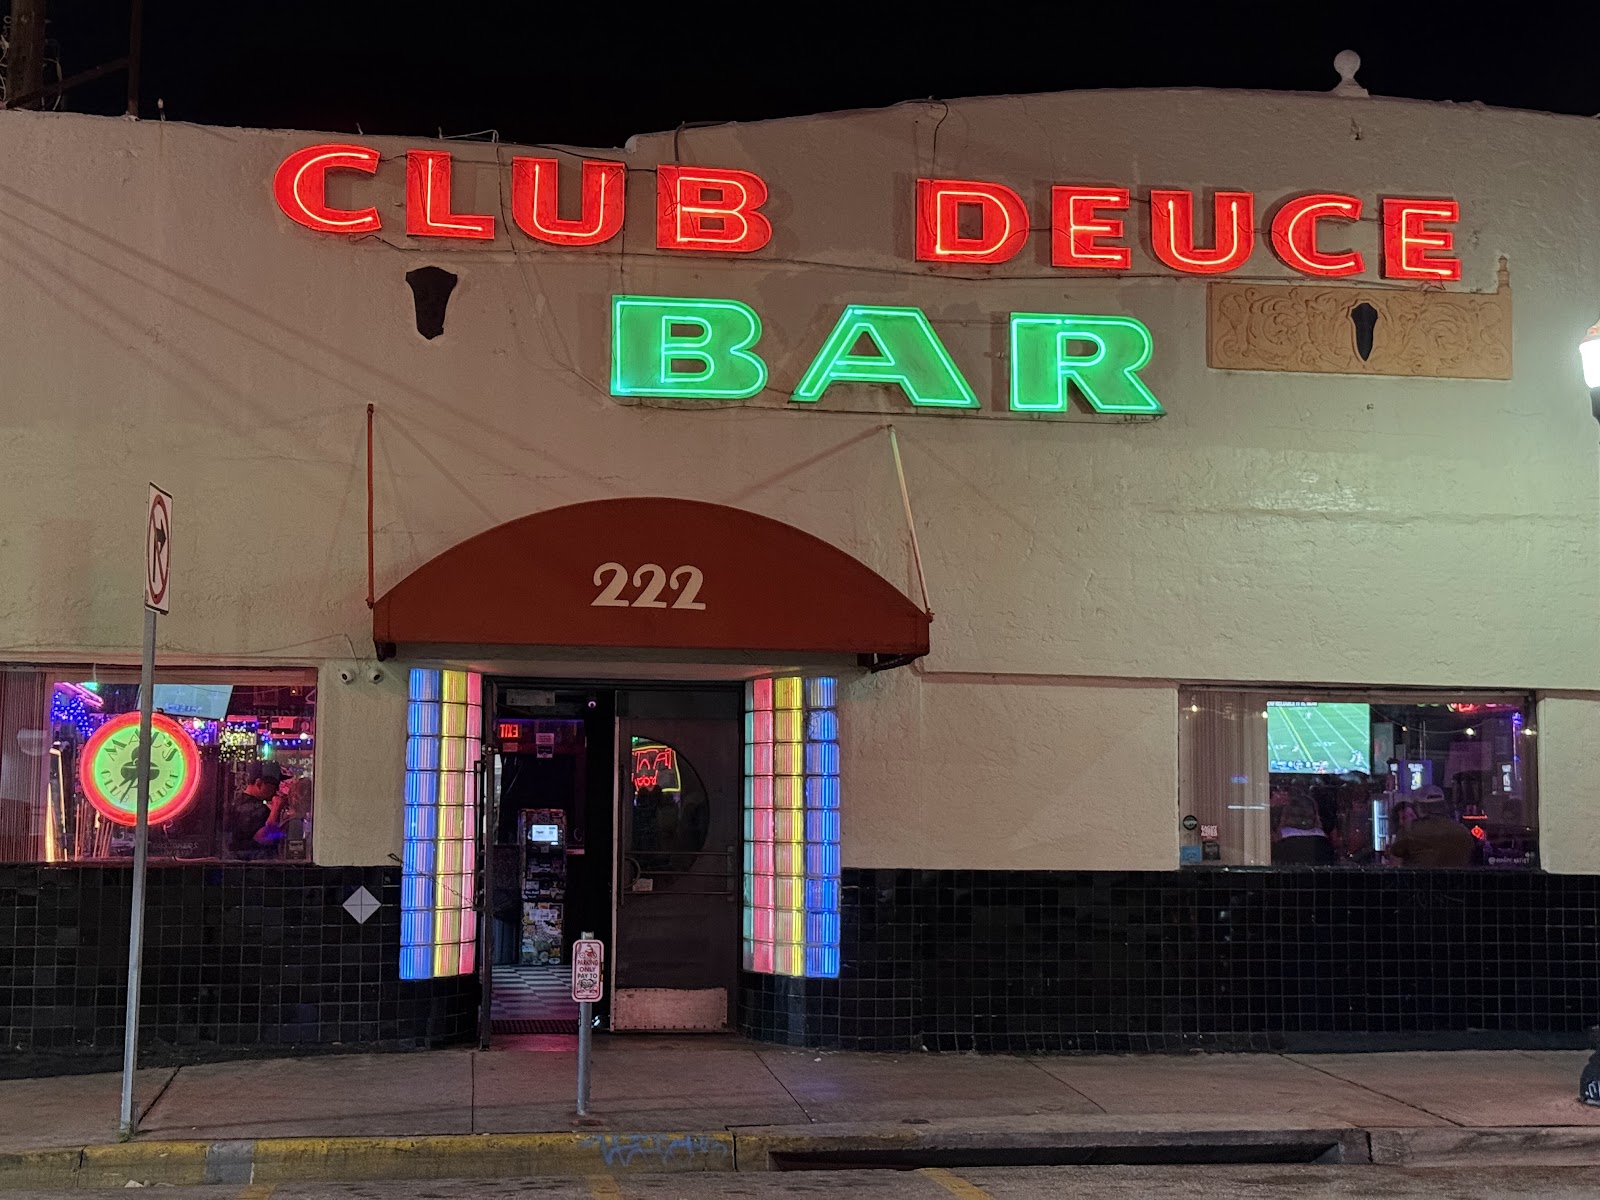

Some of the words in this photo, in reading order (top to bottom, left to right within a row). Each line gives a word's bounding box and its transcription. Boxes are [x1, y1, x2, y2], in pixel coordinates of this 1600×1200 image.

[273, 143, 773, 252] CLUB
[915, 178, 1462, 281] DEUCE
[610, 294, 1166, 416] BAR
[590, 562, 706, 610] 222
[101, 769, 130, 804] CLUB
[147, 770, 179, 804] EUCE
